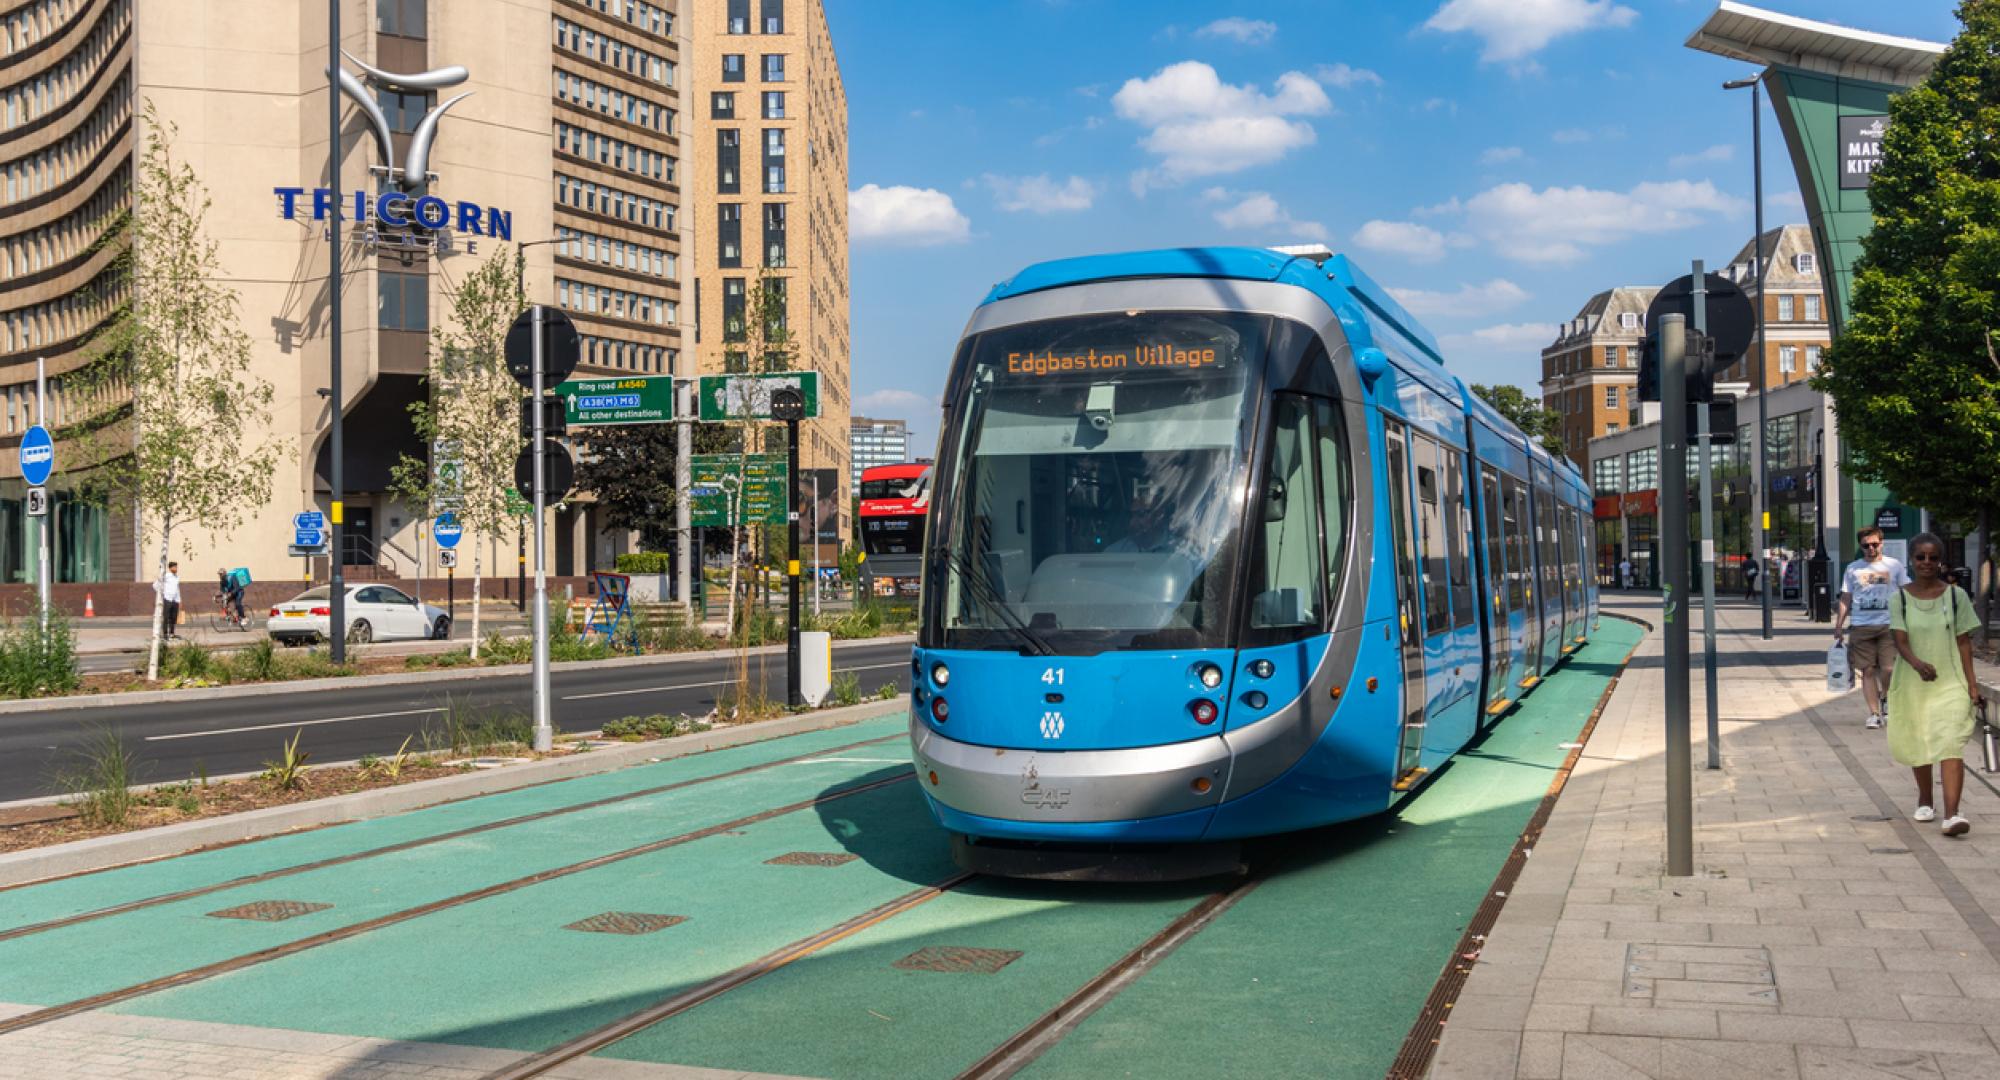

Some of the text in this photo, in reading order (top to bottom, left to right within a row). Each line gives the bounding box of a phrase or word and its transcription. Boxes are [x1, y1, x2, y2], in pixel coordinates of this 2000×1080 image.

[1848, 142, 1886, 156] MAR
[274, 187, 512, 241] TRICORN
[1008, 343, 1215, 376] Edgbaston Village
[578, 380, 647, 391] Ring road A4540
[578, 409, 662, 420] All other destinations
[1041, 668, 1065, 685] 41
